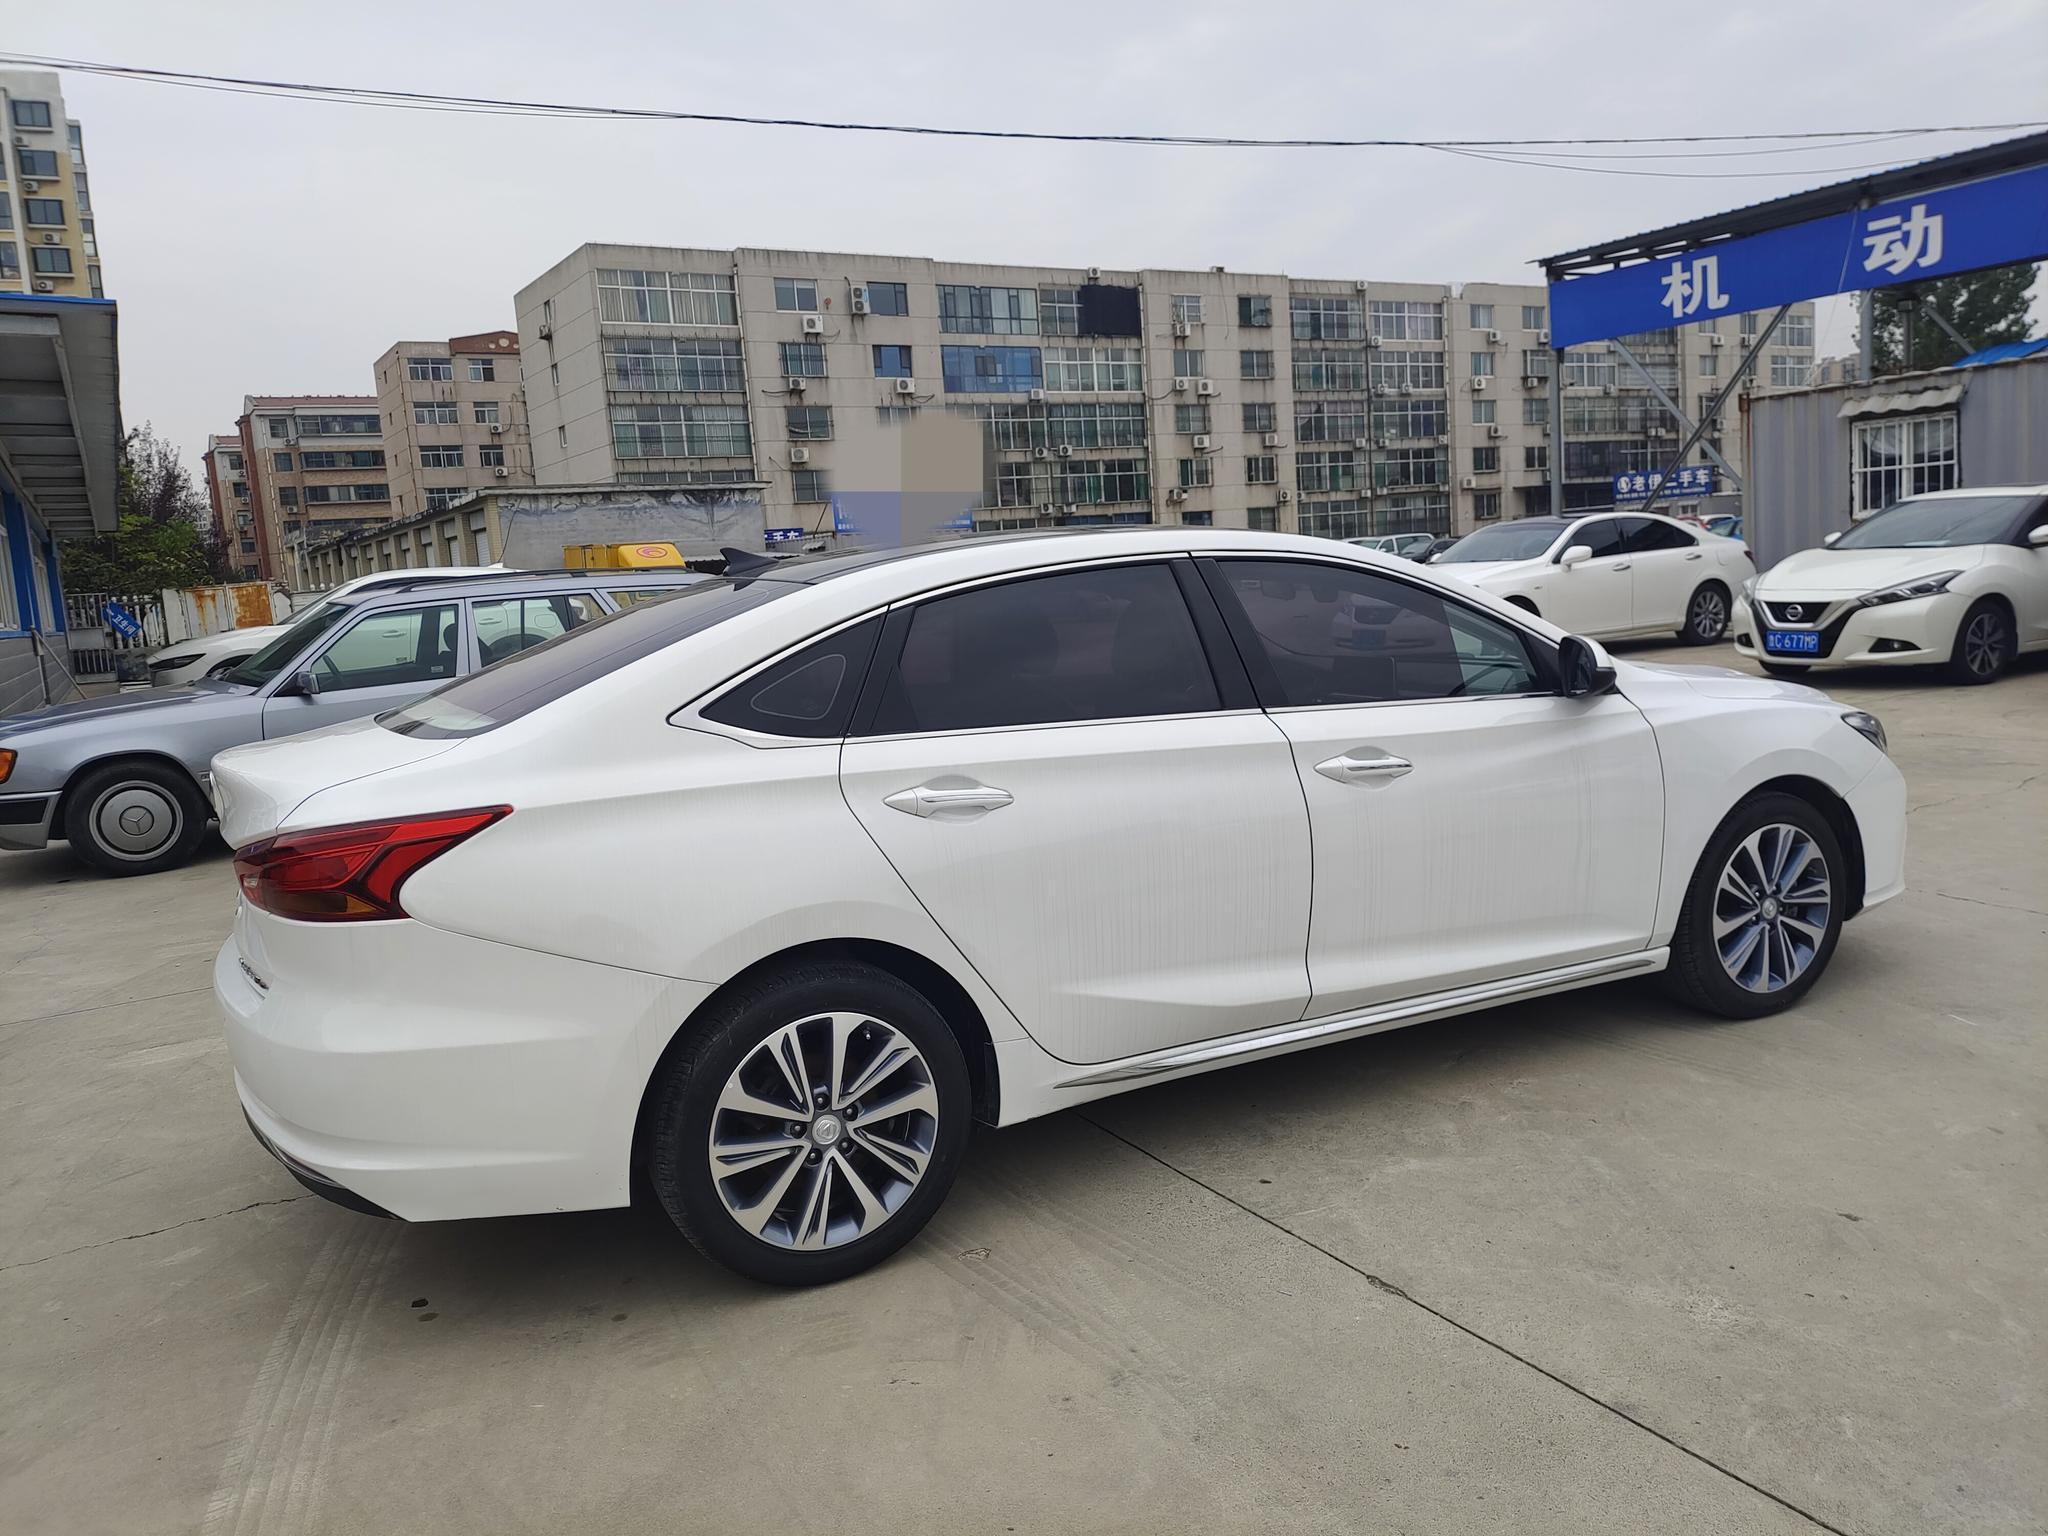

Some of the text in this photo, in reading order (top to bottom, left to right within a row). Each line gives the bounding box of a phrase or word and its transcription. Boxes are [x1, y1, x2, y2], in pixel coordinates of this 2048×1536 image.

[1661, 204, 1944, 319] 机动
[112, 614, 136, 635] 卫生间
